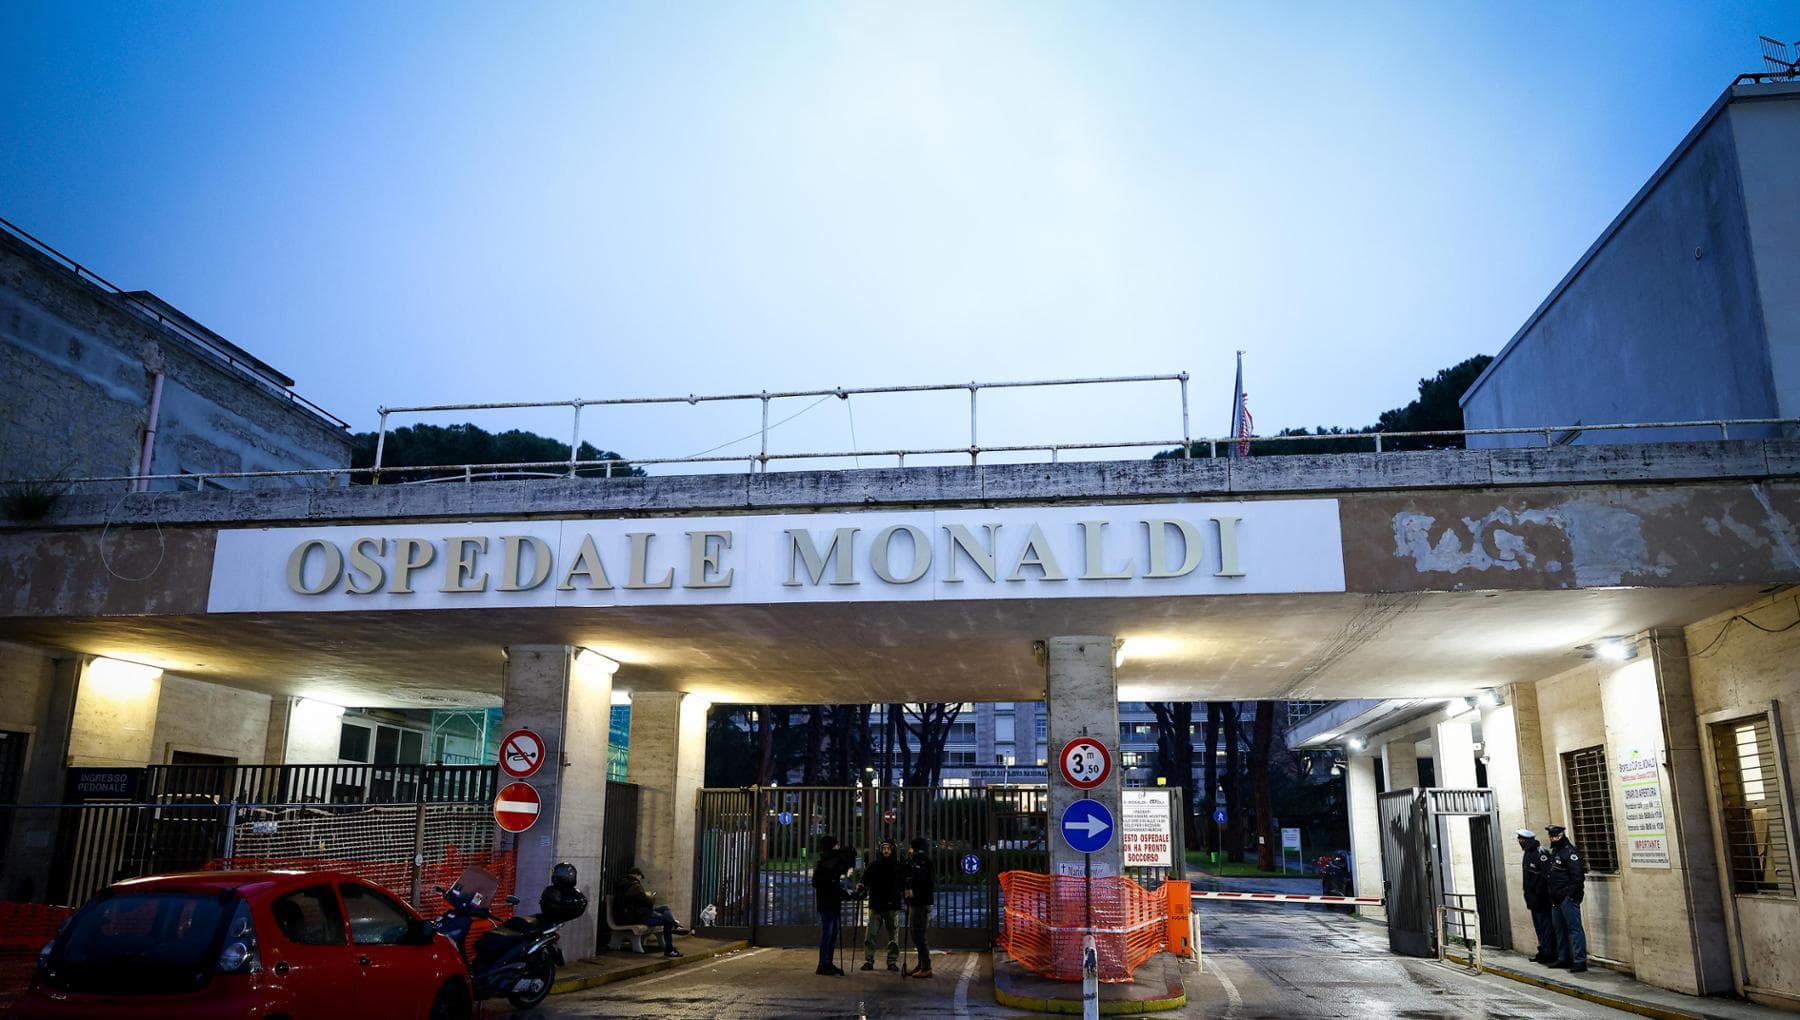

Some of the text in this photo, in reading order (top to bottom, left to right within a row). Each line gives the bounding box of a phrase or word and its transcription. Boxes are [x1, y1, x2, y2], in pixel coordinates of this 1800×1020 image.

[286, 517, 1247, 596] OSPEDALE MONALDI
[1072, 753, 1084, 774] 3
[80, 773, 128, 783] INGRESSO
[78, 783, 128, 792] PEDONALE
[1140, 833, 1169, 843] OSPEDALE
[1134, 843, 1142, 852] HA
[1144, 843, 1167, 852] PRONTO
[1128, 853, 1159, 862] SOCCORSO
